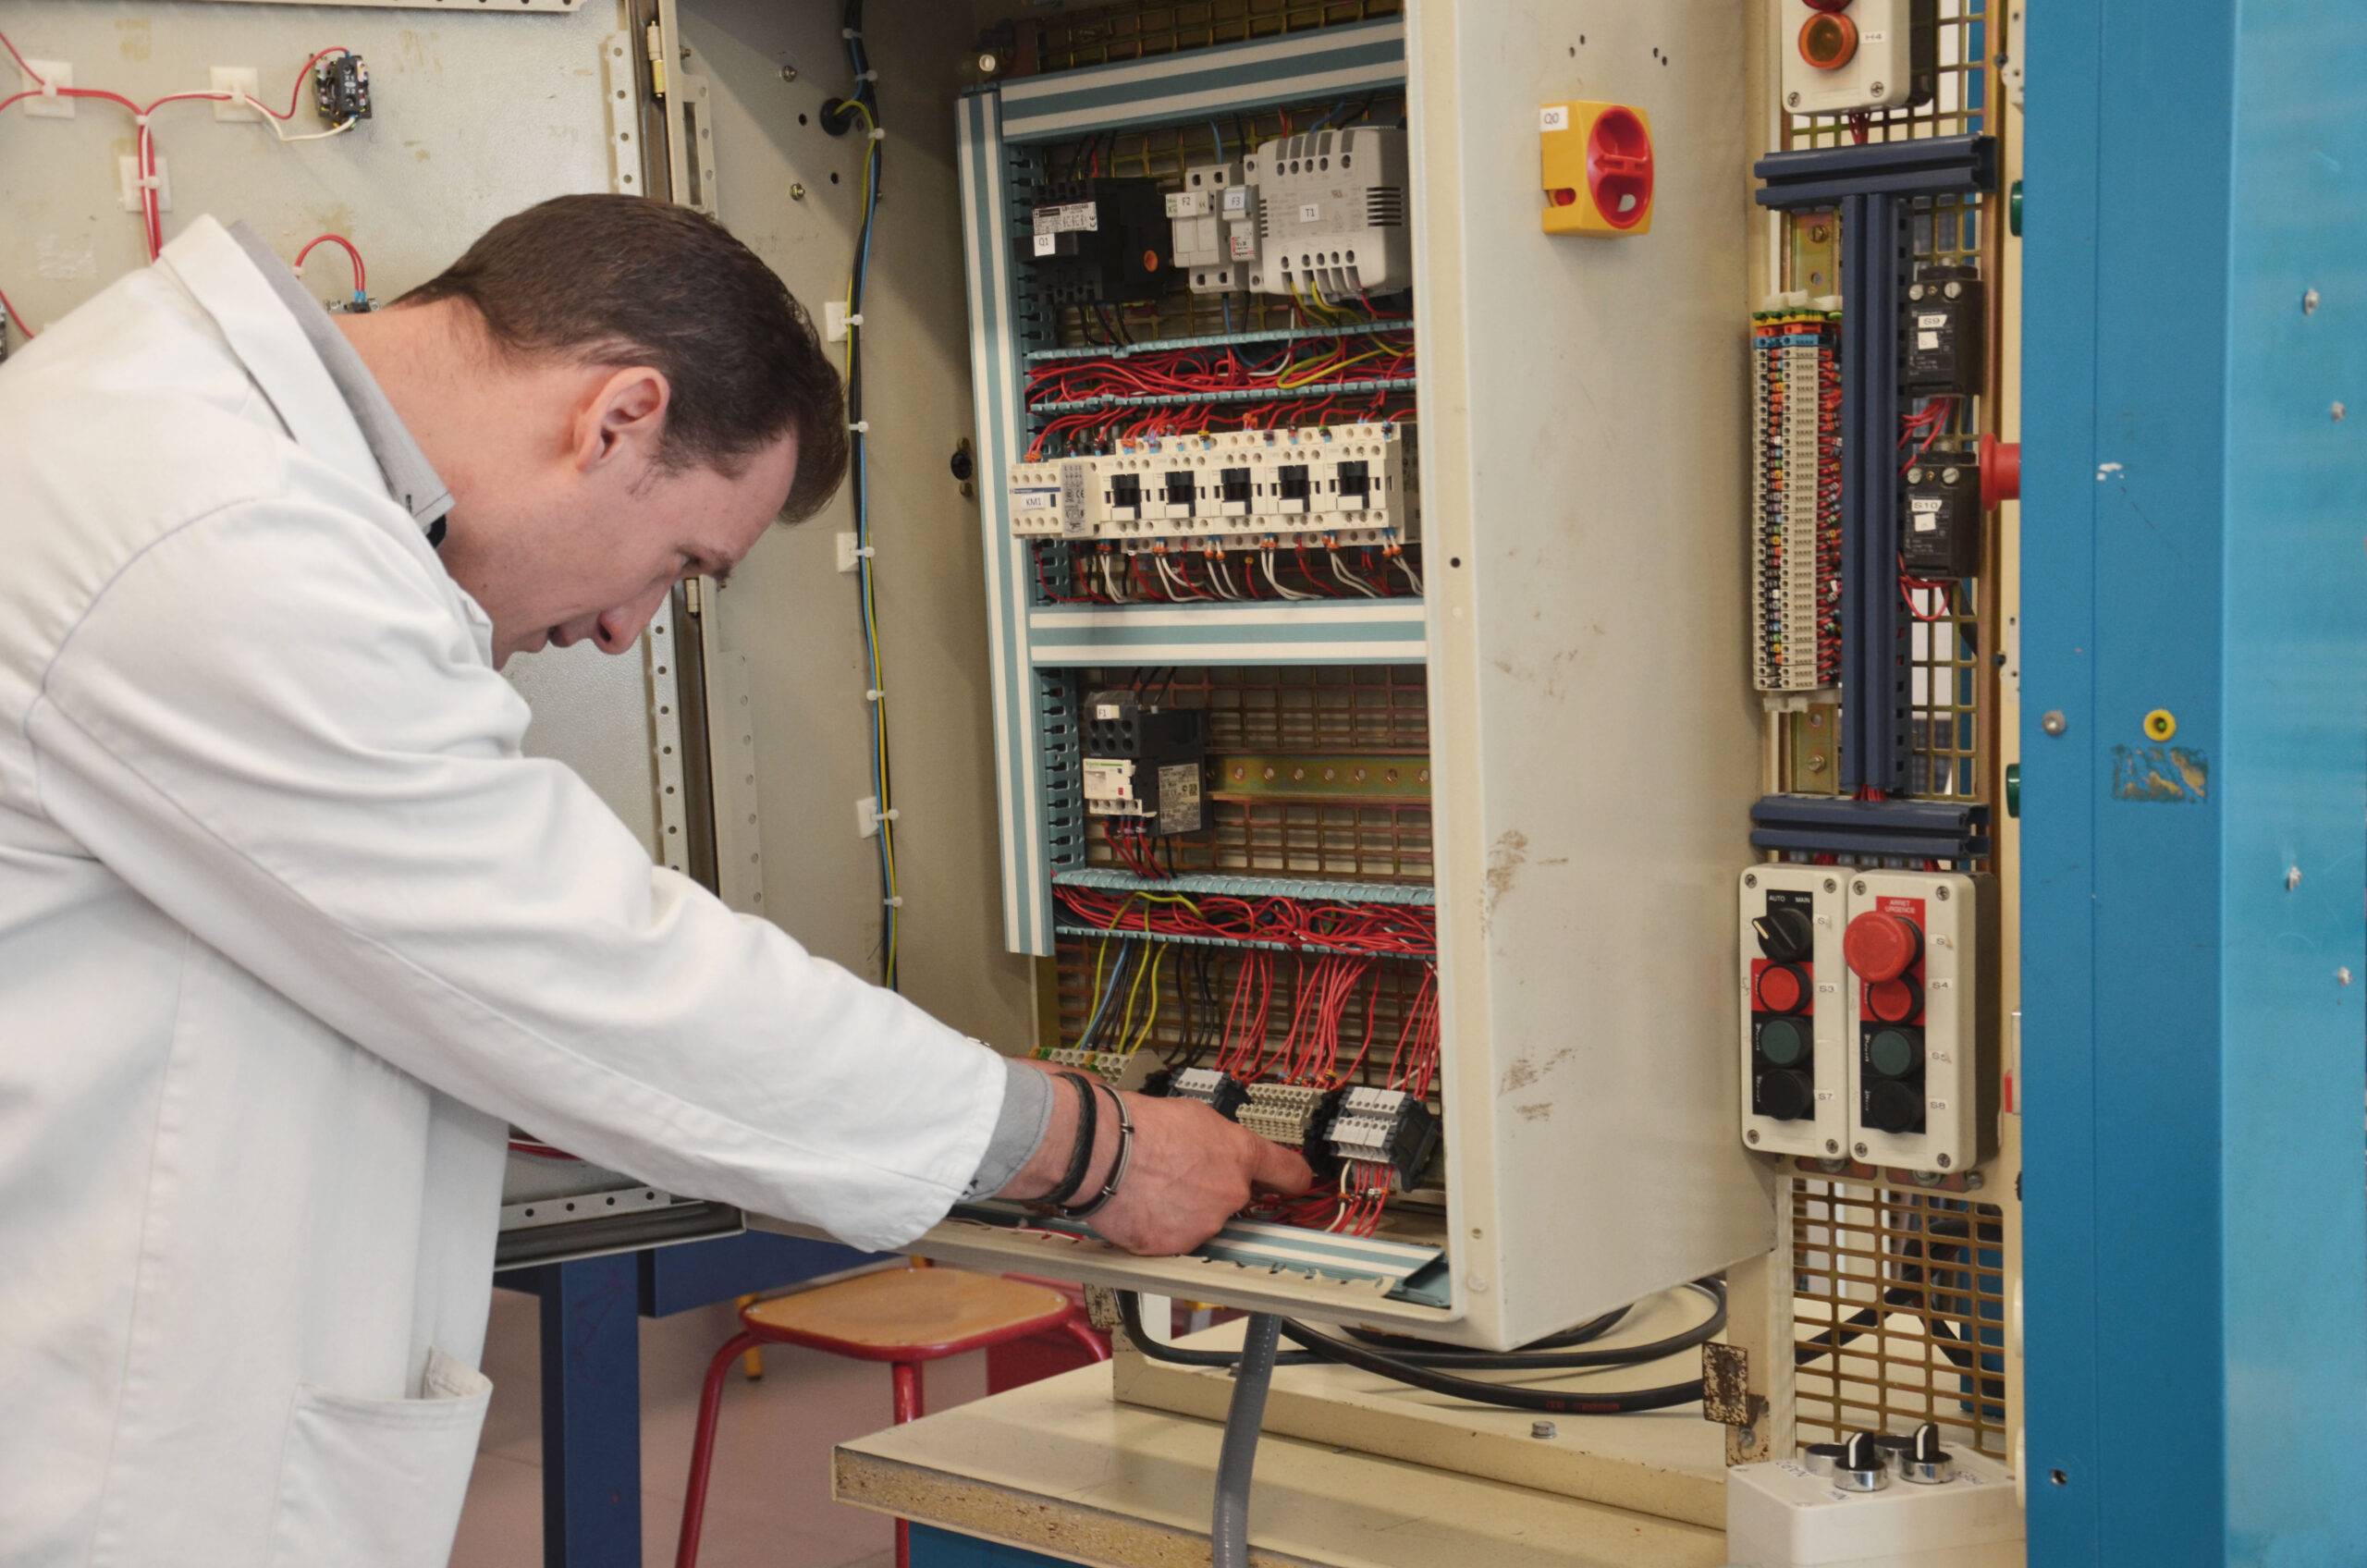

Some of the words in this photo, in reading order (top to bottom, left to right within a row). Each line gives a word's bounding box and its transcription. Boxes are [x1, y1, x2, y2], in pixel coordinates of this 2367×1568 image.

[1182, 196, 1191, 206] F2
[1232, 196, 1241, 206] F3
[1305, 208, 1316, 218] T1
[1038, 237, 1049, 247] Q1
[1923, 317, 1941, 325] S9
[1025, 497, 1042, 507] KM1
[1913, 501, 1939, 509] S10
[1098, 708, 1108, 717] F1
[1819, 985, 1835, 994] S3
[1932, 981, 1949, 990] S4
[1818, 1093, 1834, 1101] S7
[1930, 1100, 1946, 1110] S8
